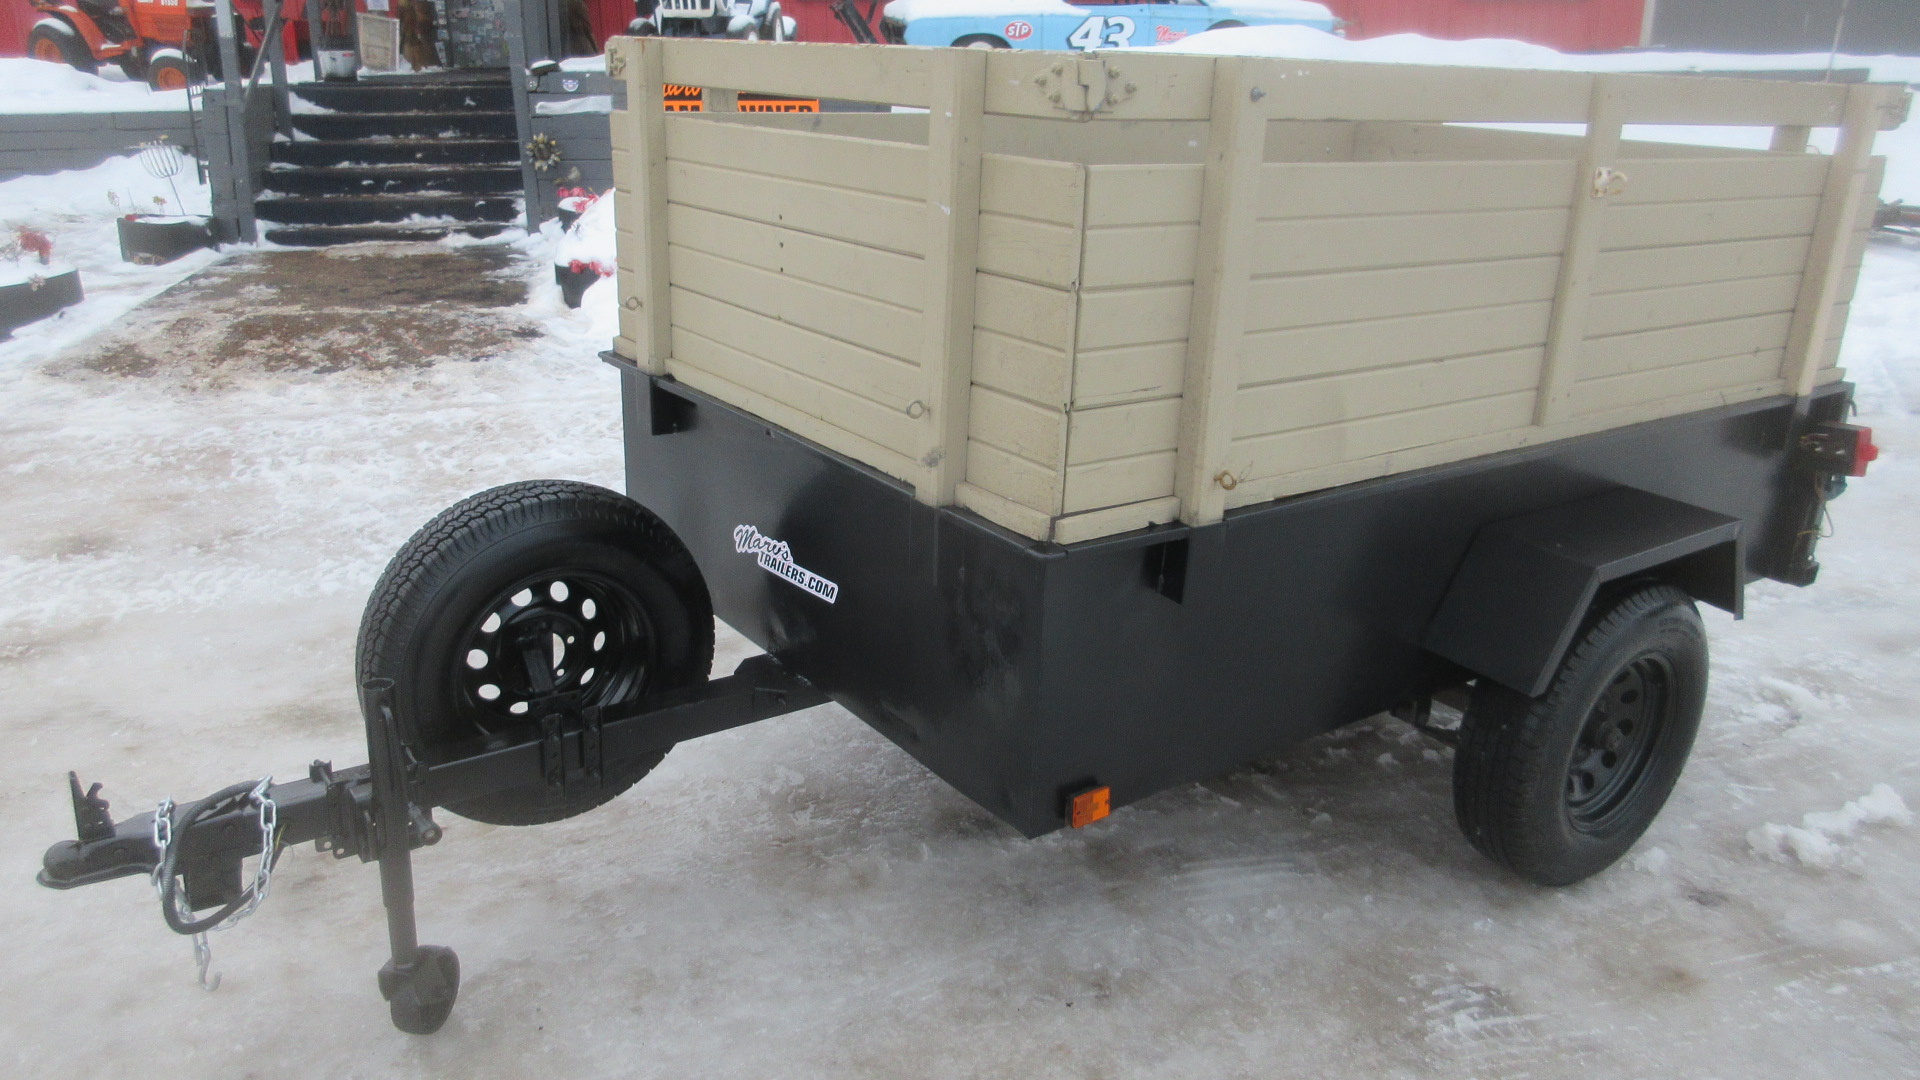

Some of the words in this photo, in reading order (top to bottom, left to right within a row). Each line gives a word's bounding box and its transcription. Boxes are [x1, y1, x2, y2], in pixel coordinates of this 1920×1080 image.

[1007, 22, 1029, 38] STP
[1066, 15, 1136, 51] 43
[735, 528, 791, 562] Marv's
[760, 550, 836, 600] TRAILERS.COM
